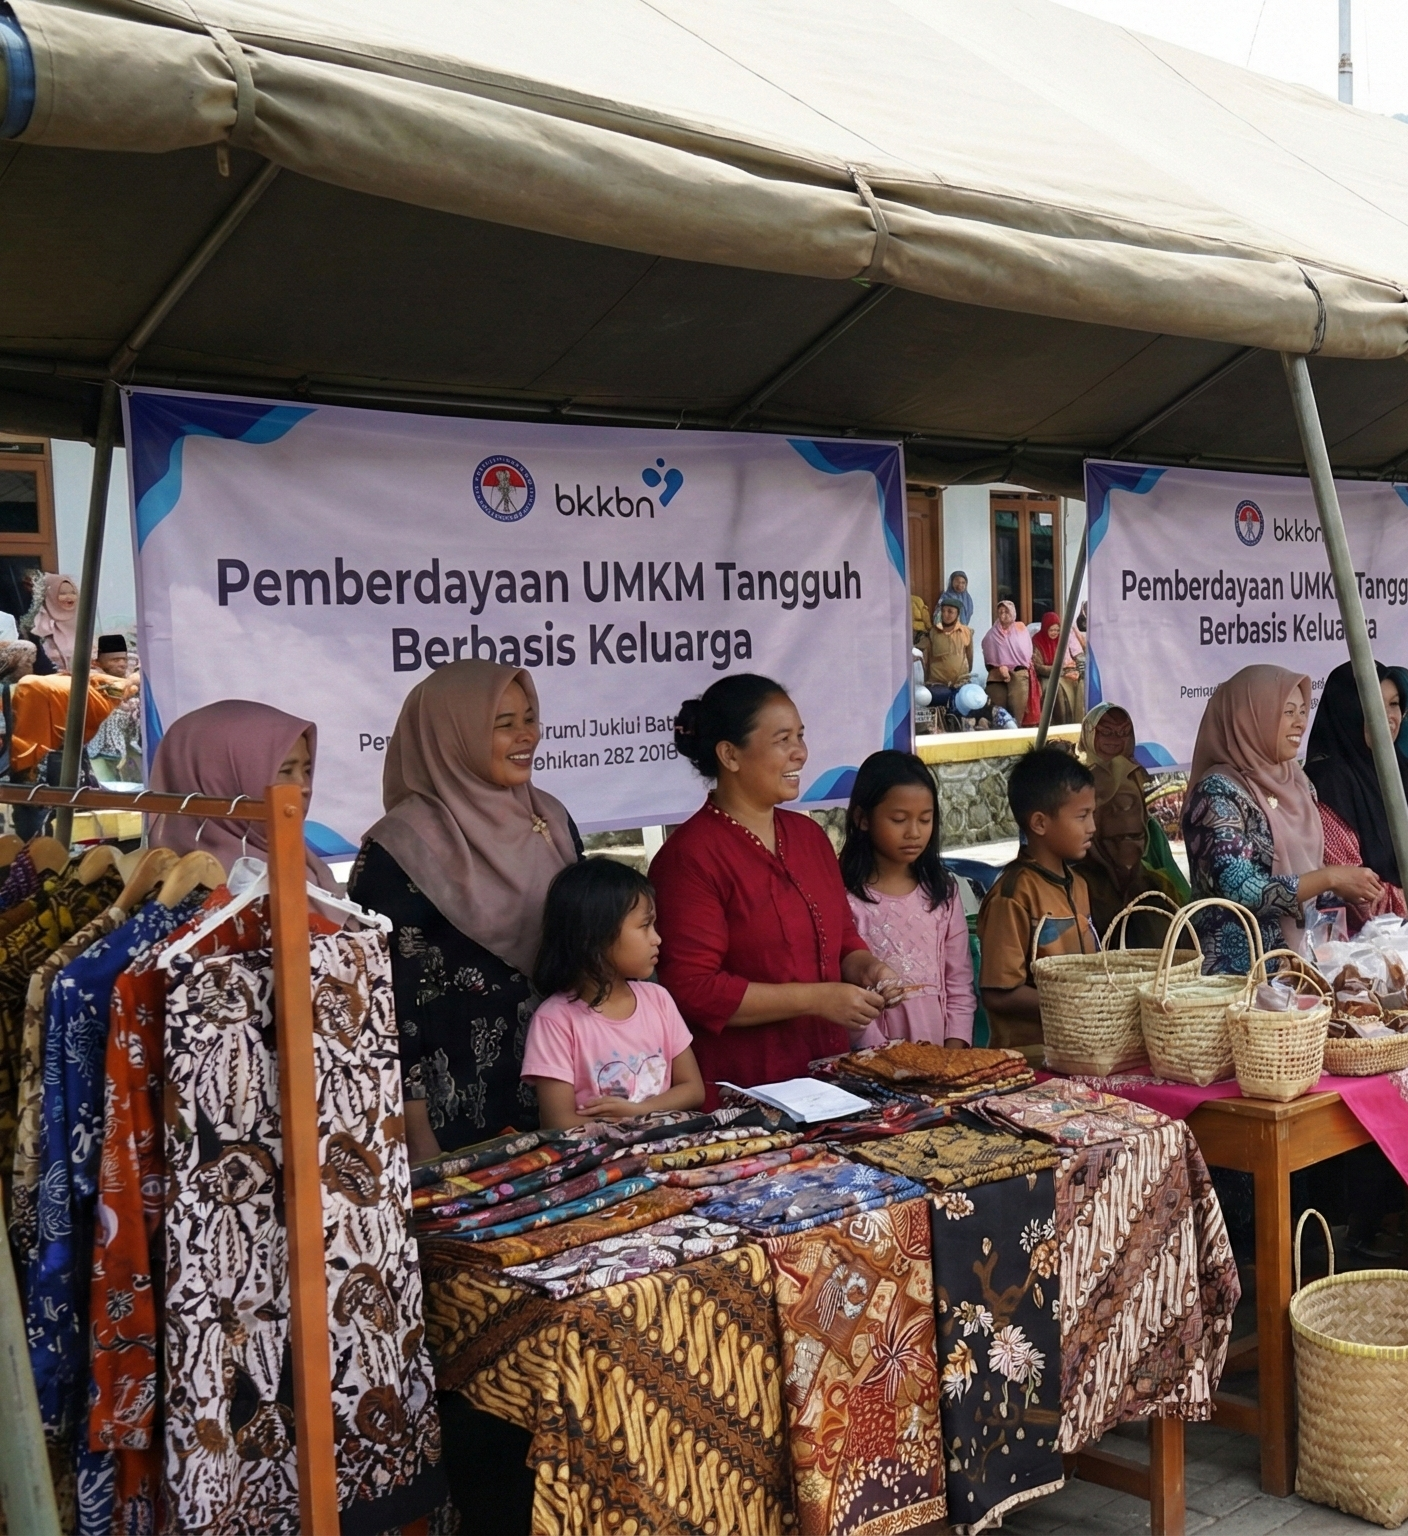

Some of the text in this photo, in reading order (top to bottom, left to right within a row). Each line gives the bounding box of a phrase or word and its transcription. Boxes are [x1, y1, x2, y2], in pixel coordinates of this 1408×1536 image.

[555, 483, 655, 518] bkkbn
[217, 556, 862, 616] Pemberdayaan UMKM Tangguh
[1122, 568, 1284, 608] Pemberdayaan
[1290, 571, 1338, 600] UMK
[392, 620, 752, 673] Berbasis Keluarga
[1200, 611, 1377, 646] Berbasis Keluaa
[603, 747, 635, 766] 282
